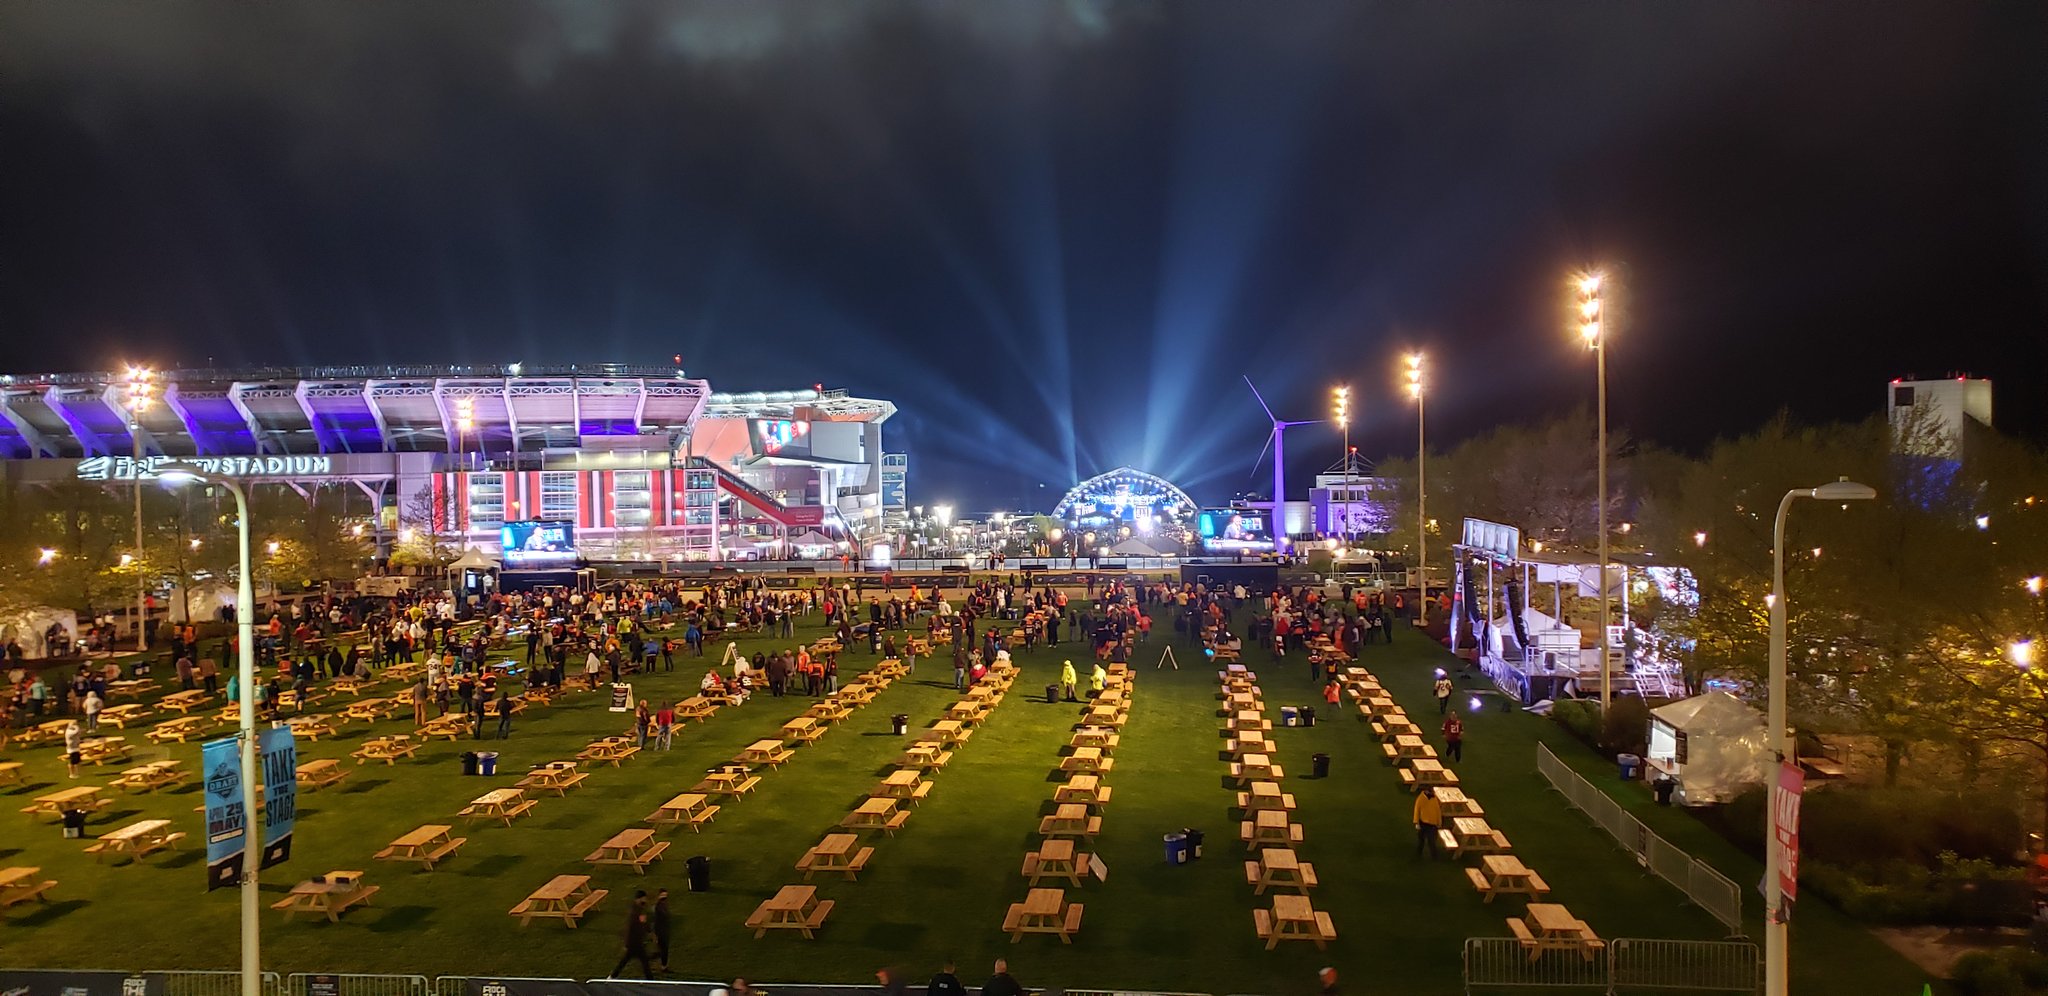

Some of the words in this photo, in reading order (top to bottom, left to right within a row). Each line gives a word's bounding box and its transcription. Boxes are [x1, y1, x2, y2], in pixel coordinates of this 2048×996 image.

[221, 456, 330, 473] STADIUM
[262, 747, 296, 788] TAKE
[209, 776, 238, 790] DRAFT
[266, 793, 295, 827] STAGE
[209, 816, 240, 834] MAY
